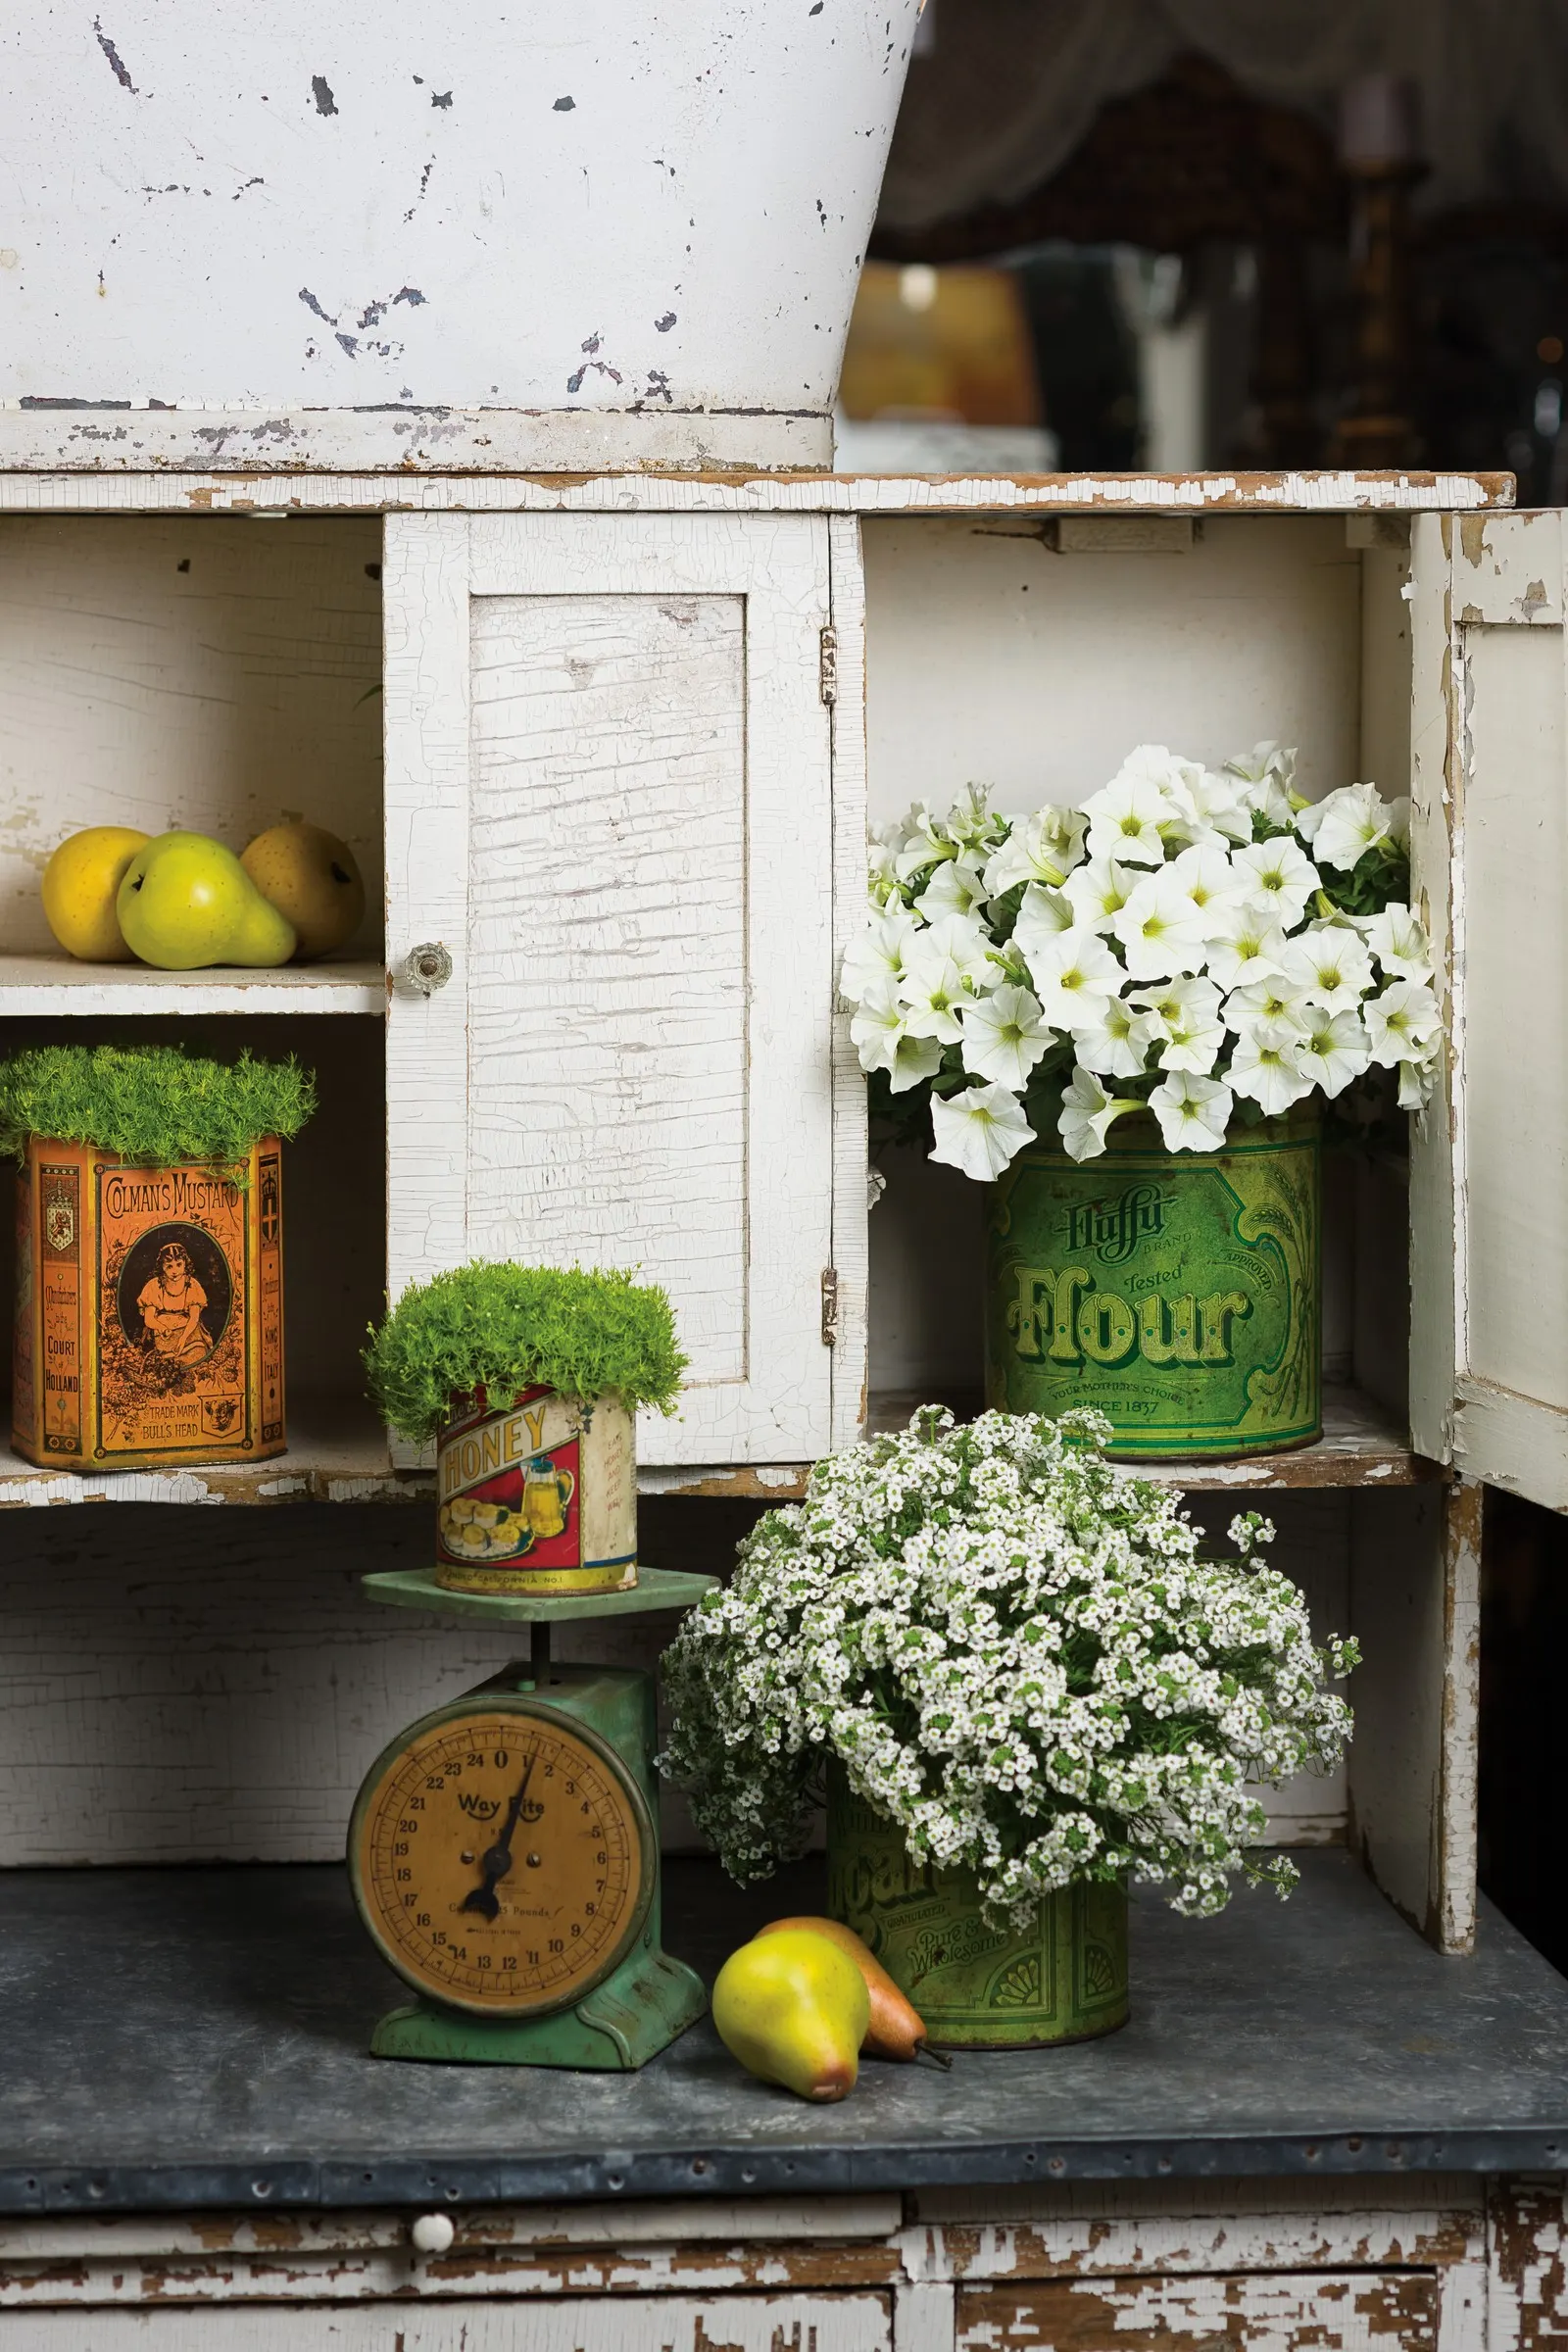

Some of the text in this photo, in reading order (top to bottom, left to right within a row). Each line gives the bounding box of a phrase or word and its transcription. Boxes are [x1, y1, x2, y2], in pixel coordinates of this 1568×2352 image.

[106, 1173, 240, 1221] COLMAN'S MUSTARD
[1055, 1184, 1179, 1264] Fluffy
[1143, 1233, 1193, 1254] BRAND
[1225, 1252, 1273, 1291] APPROVED
[1124, 1264, 1184, 1295] Tested
[1007, 1266, 1254, 1370] Flour
[47, 1335, 75, 1356] COURT
[264, 1360, 278, 1382] ITALY
[45, 1368, 78, 1394] HOLLAND
[1051, 1382, 1186, 1405] YOUR MOTHER'S CHOICE
[150, 1404, 199, 1420] TRADE MARK
[1126, 1401, 1159, 1416] 1837
[142, 1422, 198, 1440] BULL'S HEAD
[445, 1405, 546, 1494] HONEY
[466, 1754, 484, 1768] 24
[494, 1750, 509, 1769] 0
[444, 1763, 462, 1776] 23
[545, 1765, 554, 1778] 2
[426, 1777, 444, 1789] 22
[565, 1783, 574, 1794] 3
[410, 1797, 425, 1810] 21
[458, 1793, 501, 1820] Way
[580, 1801, 590, 1814] 4
[399, 1820, 417, 1834] 20
[592, 1827, 601, 1838] 5
[395, 1842, 409, 1856] 19
[597, 1851, 606, 1864] 6
[397, 1869, 412, 1882] 18
[596, 1881, 606, 1892] 7
[404, 1894, 418, 1906] 17
[514, 1906, 549, 1917] Pounds
[585, 1903, 595, 1916] 8
[887, 1904, 946, 1929] GRANULATED
[416, 1913, 430, 1926] 16
[570, 1925, 580, 1936] 9
[919, 1918, 981, 1950] Pure &
[432, 1933, 447, 1945] 15
[548, 1939, 564, 1952] 10
[453, 1947, 466, 1960] 14
[527, 1951, 539, 1964] 11
[910, 1933, 1005, 1973] Wholesome
[476, 1956, 491, 1969] 13
[502, 1957, 517, 1970] 12
